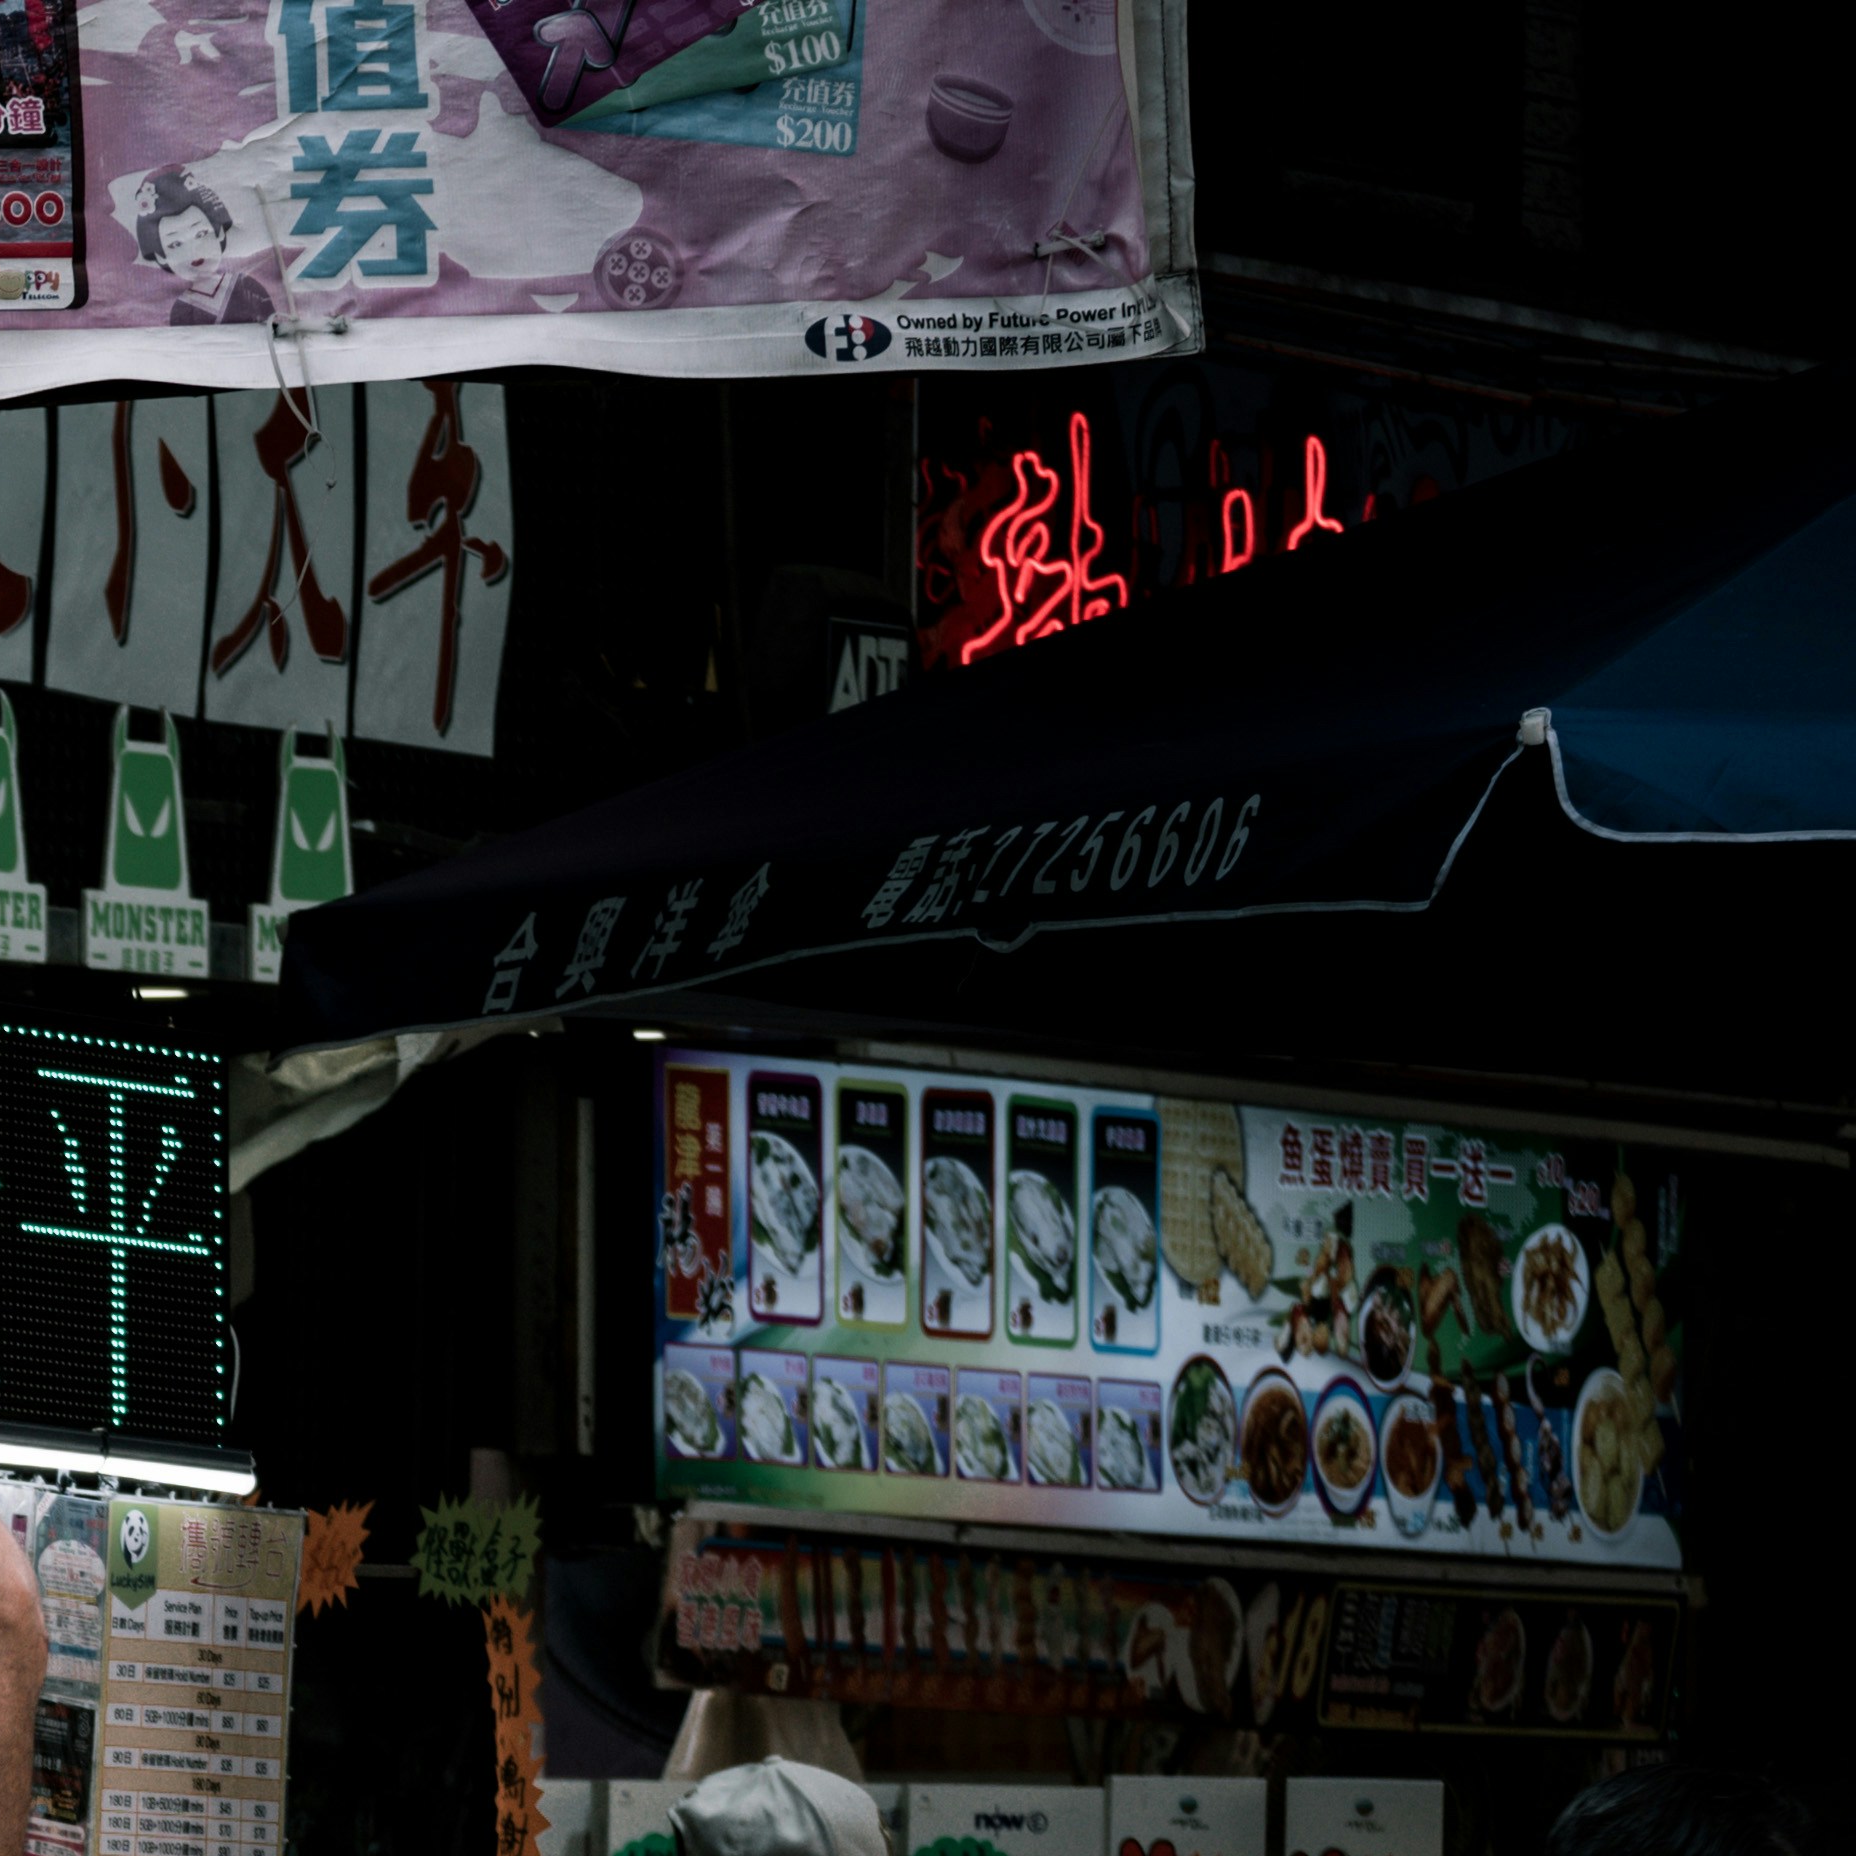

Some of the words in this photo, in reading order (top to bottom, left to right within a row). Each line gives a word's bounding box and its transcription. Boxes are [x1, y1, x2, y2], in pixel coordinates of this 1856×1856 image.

[758, 0, 829, 28] 充值券
[763, 30, 841, 76] $100
[781, 74, 858, 107] 充值券
[776, 114, 852, 153] $200
[897, 314, 957, 331] Owned
[963, 314, 983, 332] by
[1056, 307, 1115, 323] Power
[89, 899, 206, 948] MONSTER
[974, 1809, 1026, 1832] now
